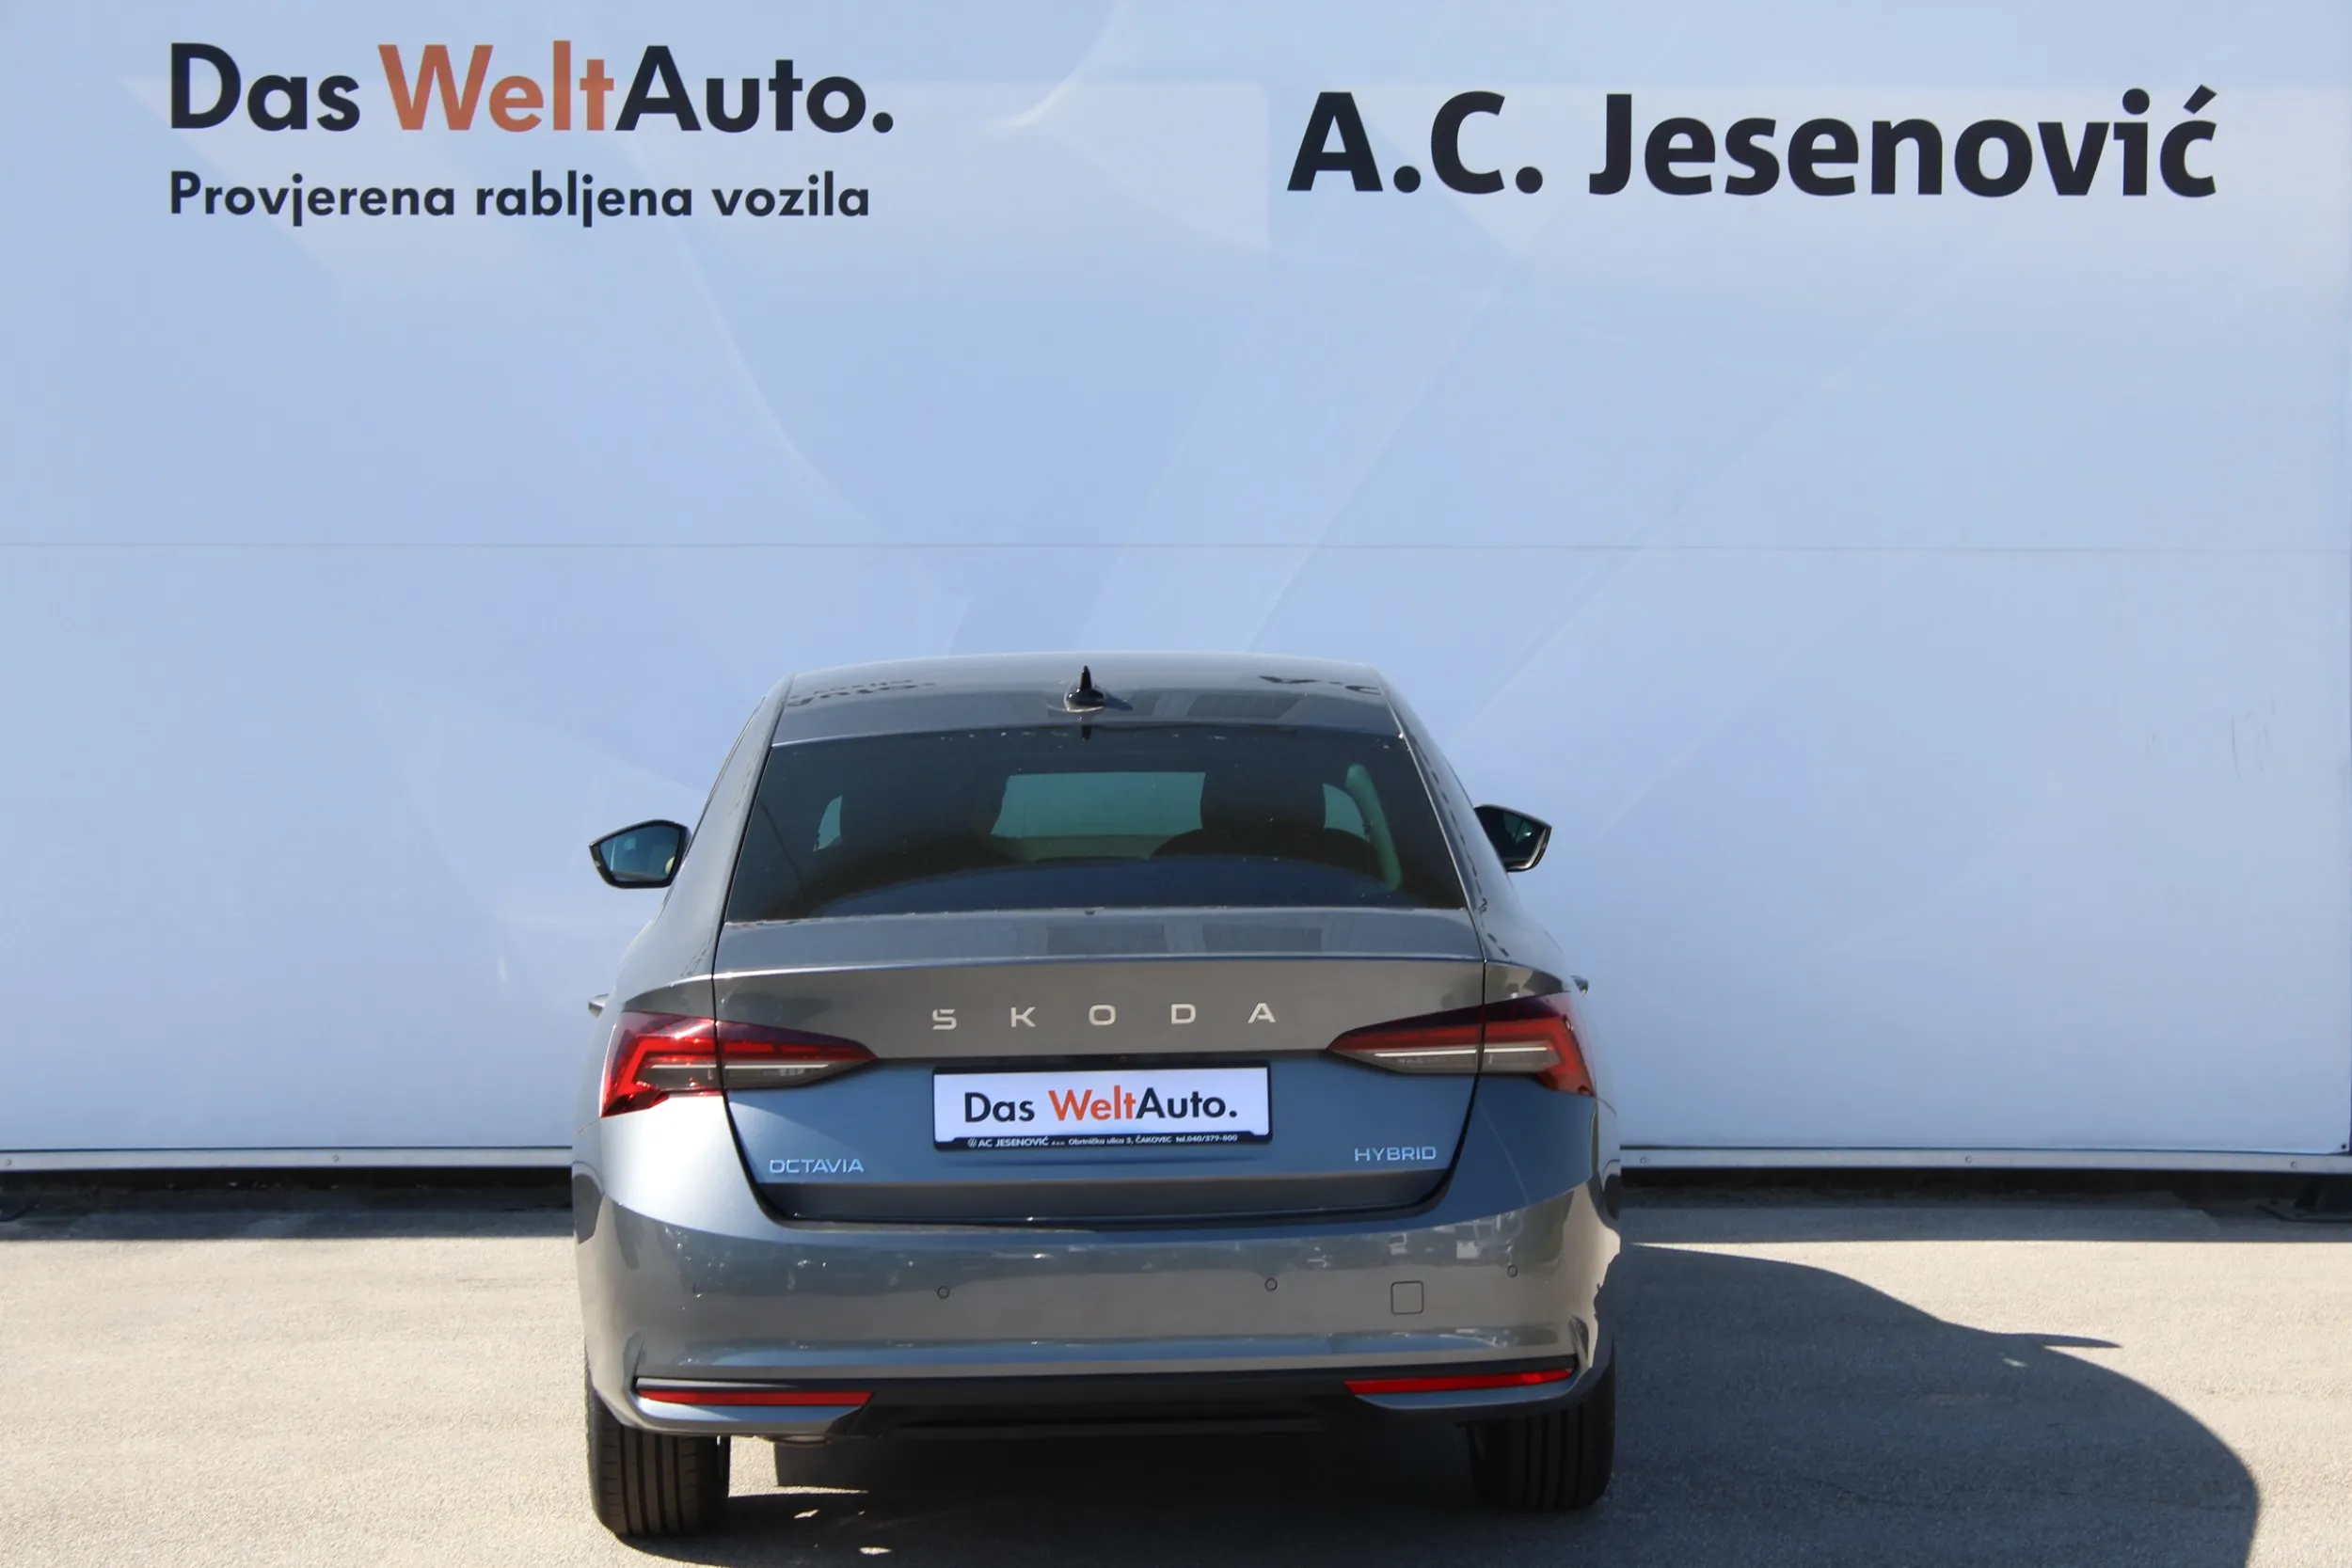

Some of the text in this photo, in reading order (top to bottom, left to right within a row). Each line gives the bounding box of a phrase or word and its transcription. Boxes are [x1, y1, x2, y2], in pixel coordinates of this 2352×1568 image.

[171, 40, 895, 135] Das WeltAuto.
[1287, 85, 2217, 198] A.C. Jesenović
[170, 169, 869, 228] Provjerena rabljena vozila
[964, 1085, 1239, 1123] Das WeltAuto.
[977, 1139, 993, 1148] AC
[994, 1135, 1049, 1148] JESENOVIĆ
[1354, 1146, 1437, 1163] HYBRID
[769, 1158, 865, 1174] OCTAVIA
